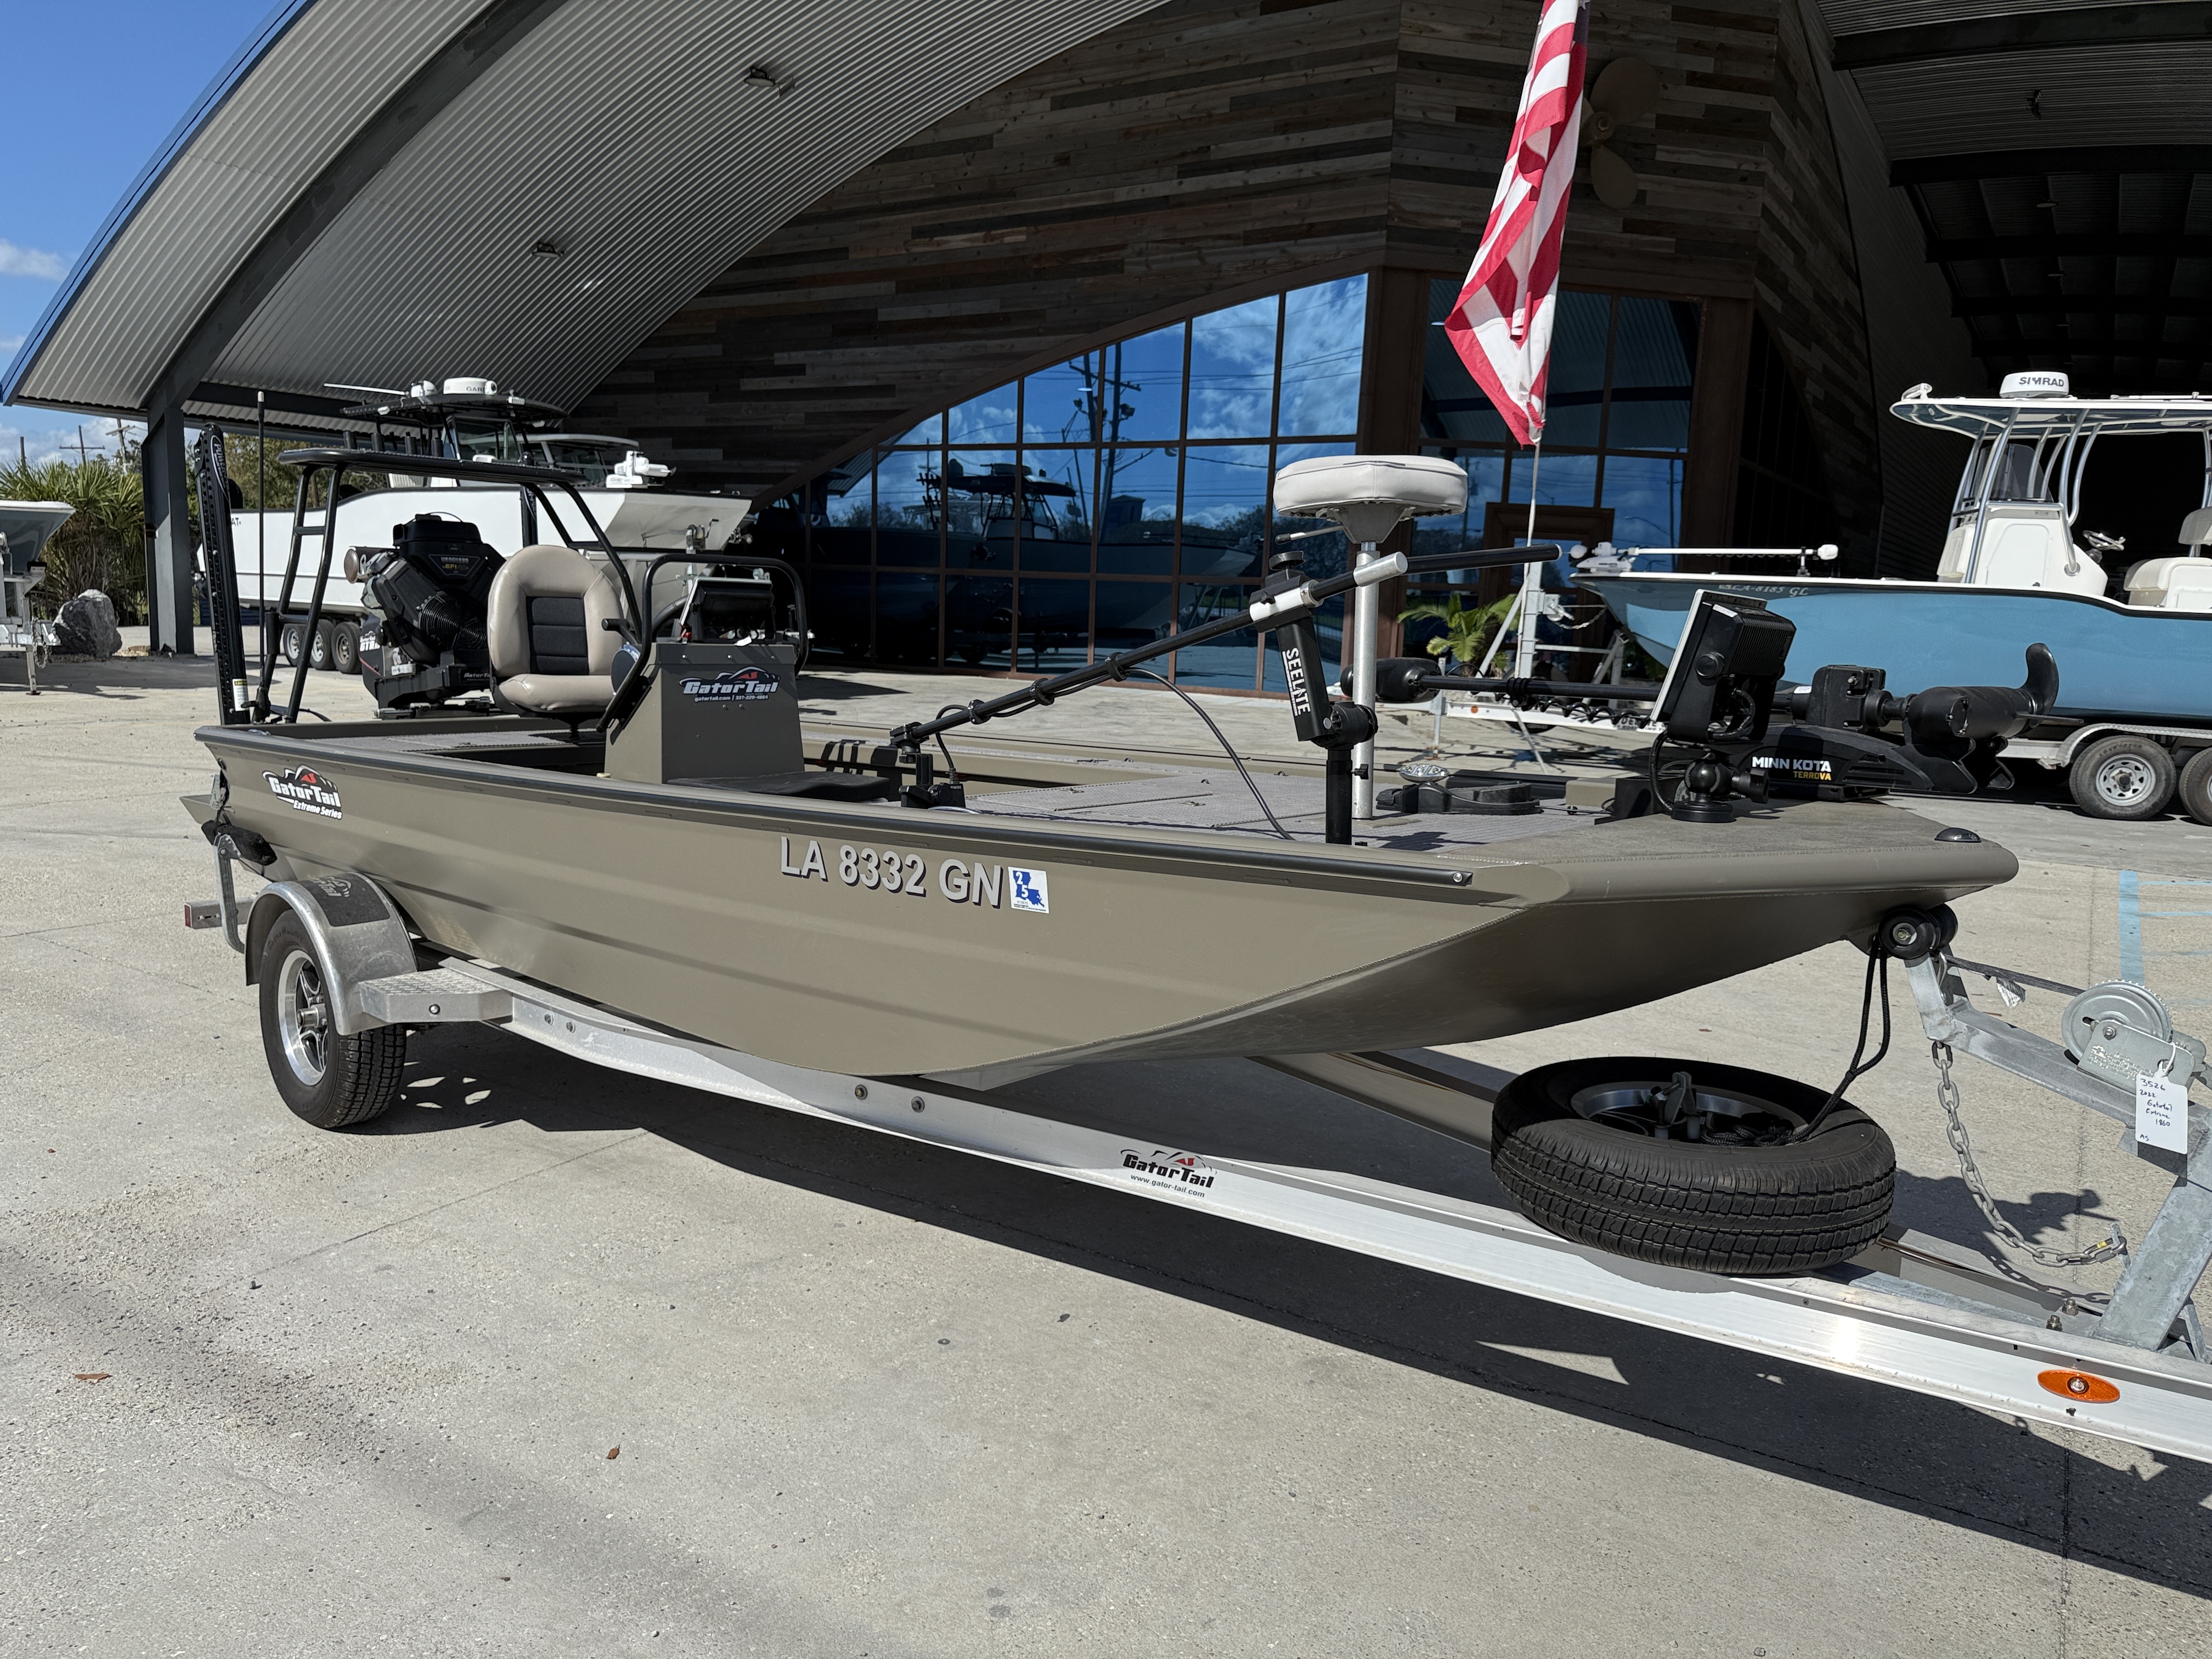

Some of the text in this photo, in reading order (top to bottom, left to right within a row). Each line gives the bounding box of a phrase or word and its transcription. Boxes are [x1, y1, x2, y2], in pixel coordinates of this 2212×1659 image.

[2019, 377, 2064, 387] SIMRAD
[683, 680, 778, 695] GatorTail
[1752, 756, 1832, 772] MINN KOTA
[1793, 771, 1832, 781] TERROVA
[268, 776, 341, 808] GatorTail
[293, 800, 342, 820] Extreme Series
[780, 836, 1003, 909] LA 8332 GN
[2140, 1078, 2165, 1091] 3526
[2140, 1089, 2157, 1098] 2022
[1122, 1154, 1215, 1189] GatorTail
[1130, 1175, 1205, 1198] www.gator-tail.com
